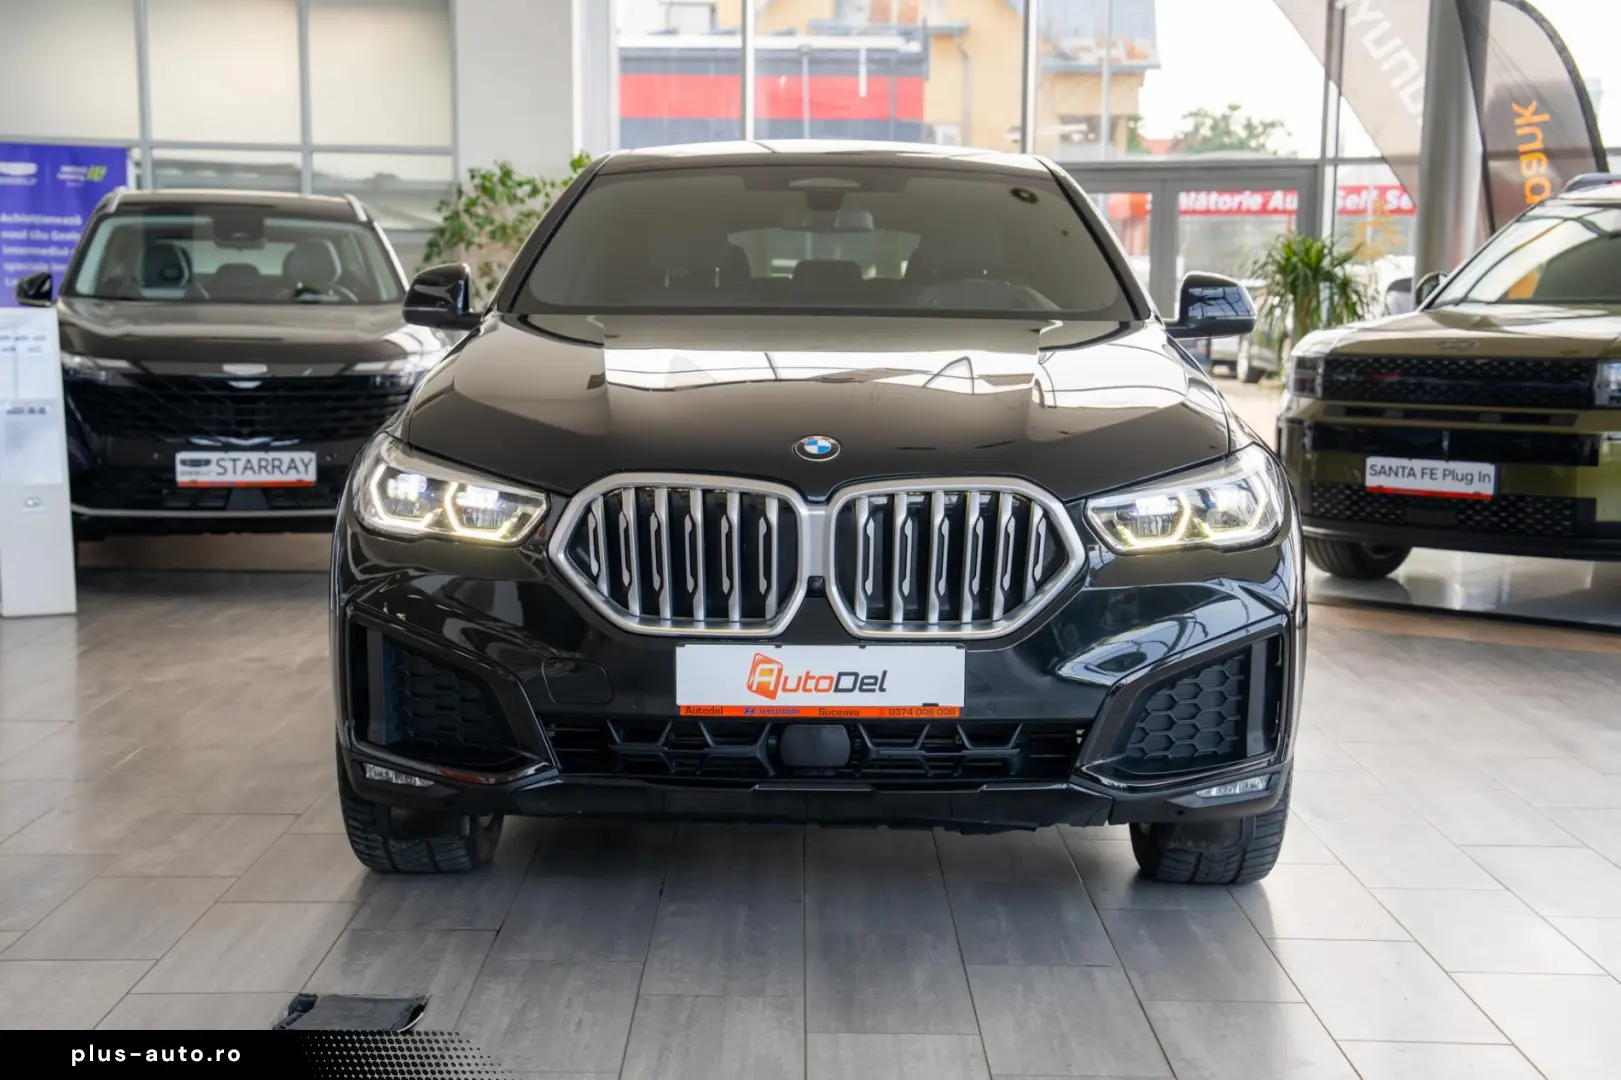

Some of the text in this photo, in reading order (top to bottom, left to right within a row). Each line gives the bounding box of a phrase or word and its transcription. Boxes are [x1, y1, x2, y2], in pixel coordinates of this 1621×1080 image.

[1347, 0, 1424, 121] YUND
[1267, 190, 1299, 211] Au
[1385, 189, 1415, 211] Se
[216, 458, 313, 476] STARRAY
[1369, 464, 1491, 485] SANTA FE Plug In
[752, 662, 887, 693] AutoDel
[684, 706, 724, 715] Autodel
[818, 707, 860, 716] Suceava
[888, 707, 913, 716] 0374
